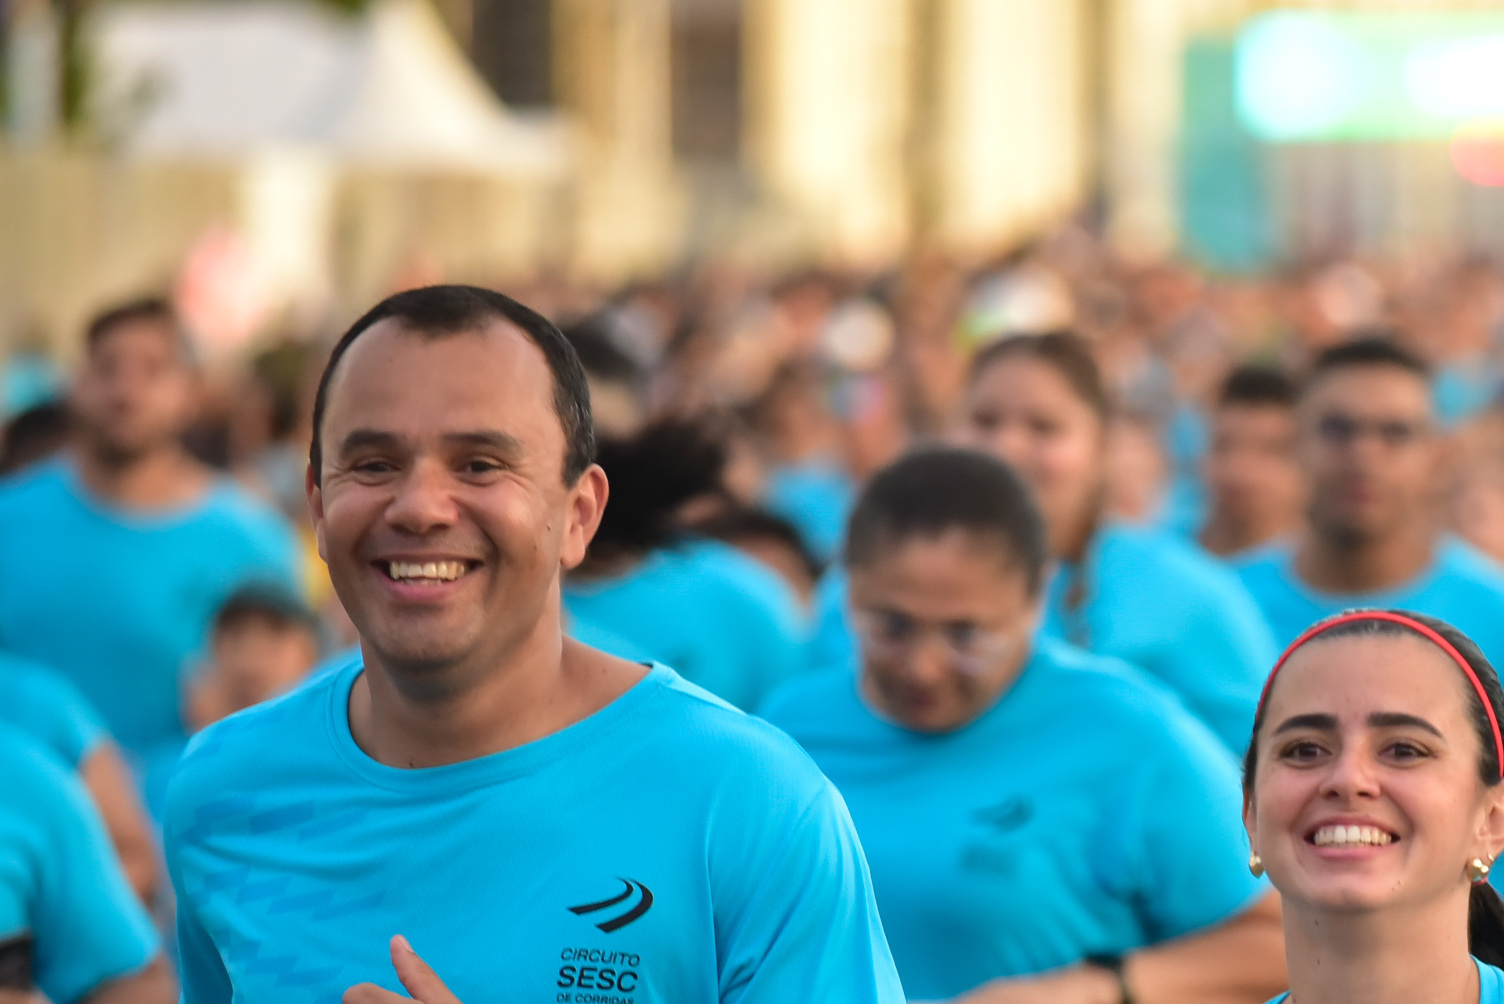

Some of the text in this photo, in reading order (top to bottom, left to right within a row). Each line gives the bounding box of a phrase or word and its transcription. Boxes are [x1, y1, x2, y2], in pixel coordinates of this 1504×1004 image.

[561, 947, 641, 967] CIRCUITO
[557, 965, 639, 993] SESC
[556, 992, 572, 1004] DE
